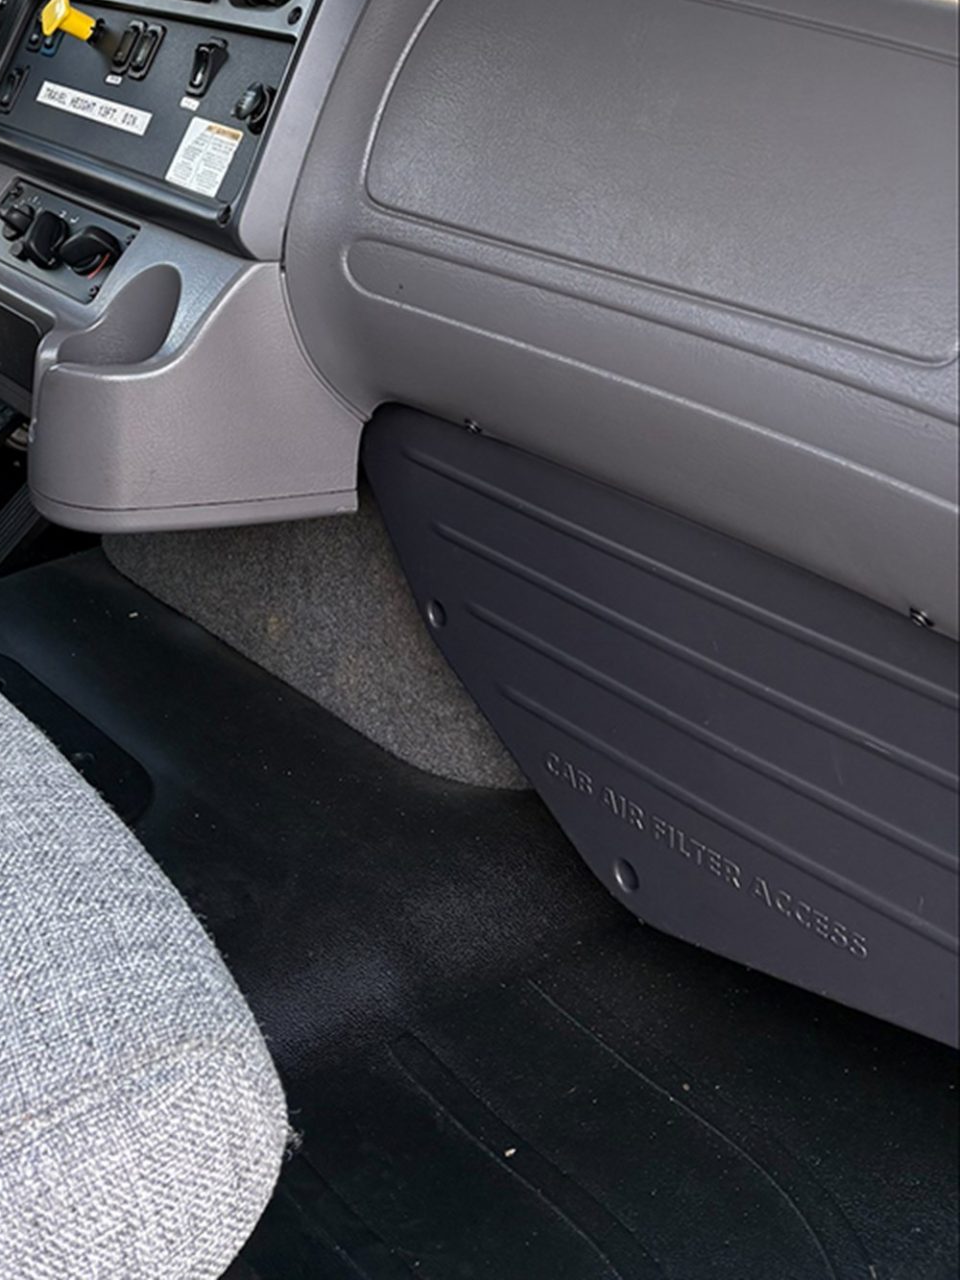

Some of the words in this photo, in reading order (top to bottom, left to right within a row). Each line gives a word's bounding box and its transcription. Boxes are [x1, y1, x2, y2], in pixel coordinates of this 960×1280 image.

[545, 751, 593, 795] CAB
[603, 787, 645, 830] AIR
[652, 816, 741, 889] FILTER
[752, 877, 868, 959] ACCESS
